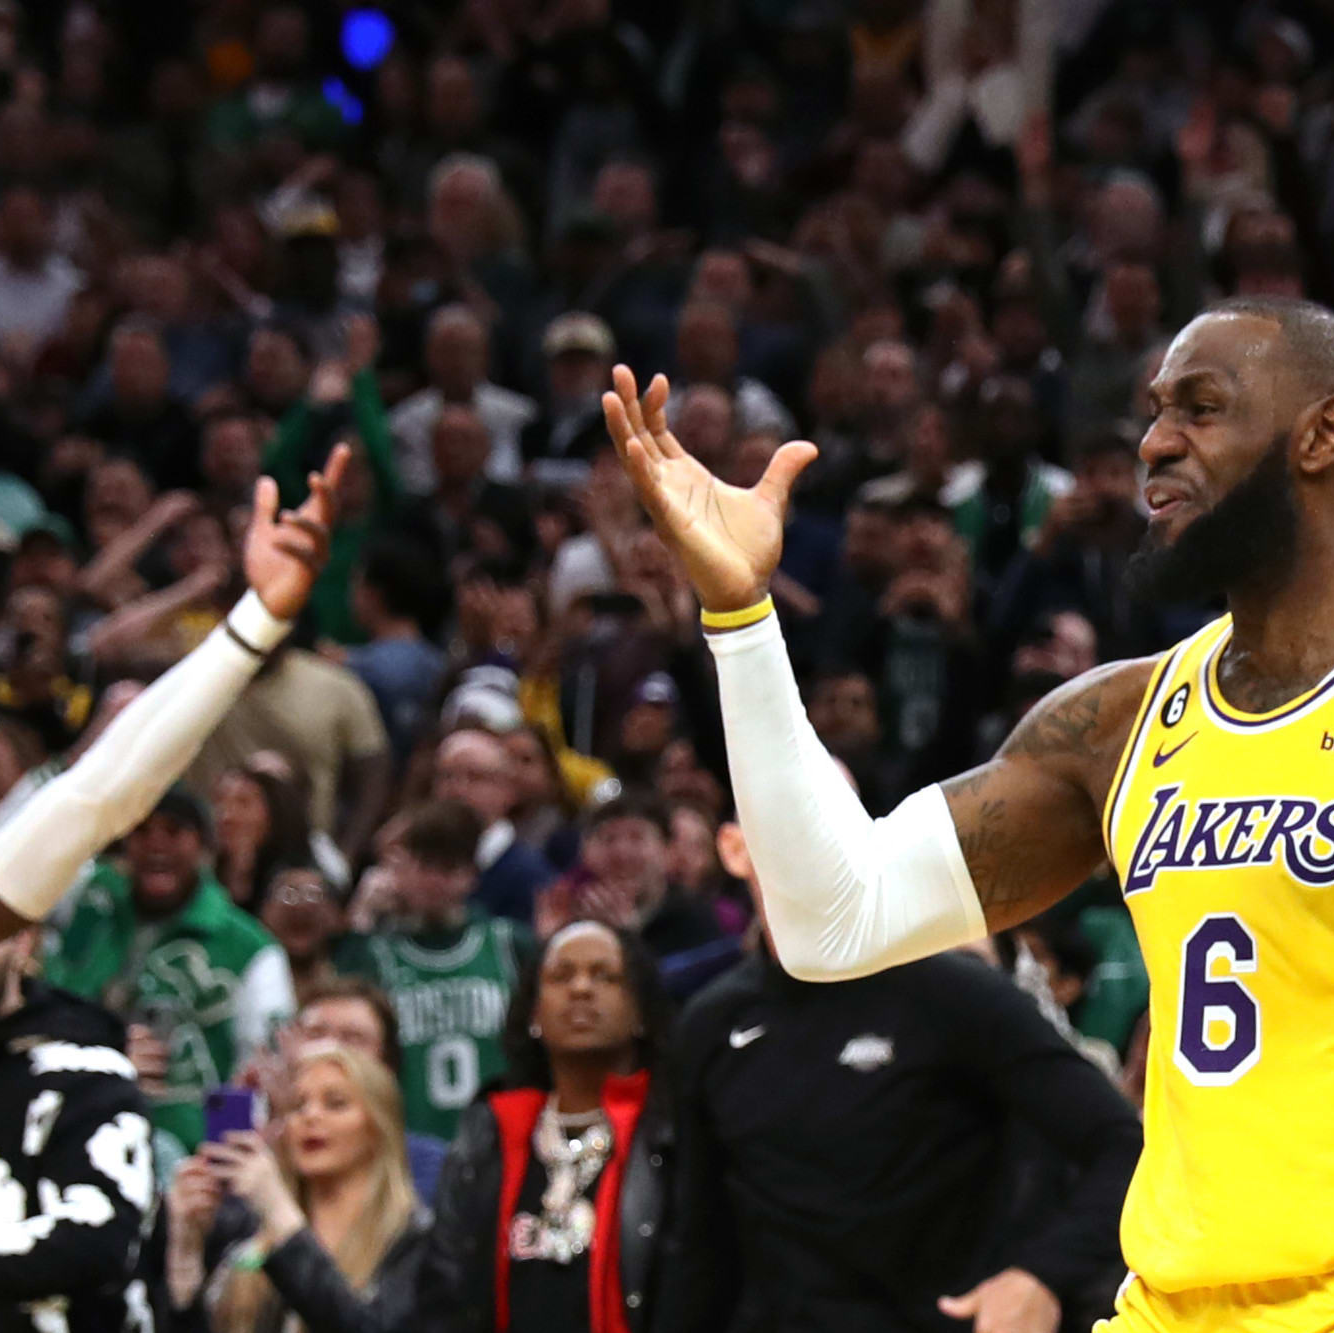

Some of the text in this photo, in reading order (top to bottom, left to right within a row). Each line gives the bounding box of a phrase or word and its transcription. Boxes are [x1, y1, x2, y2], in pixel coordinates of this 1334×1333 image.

[1166, 687, 1188, 725] 6
[1173, 912, 1262, 1087] 6
[427, 1036, 480, 1110] 0
